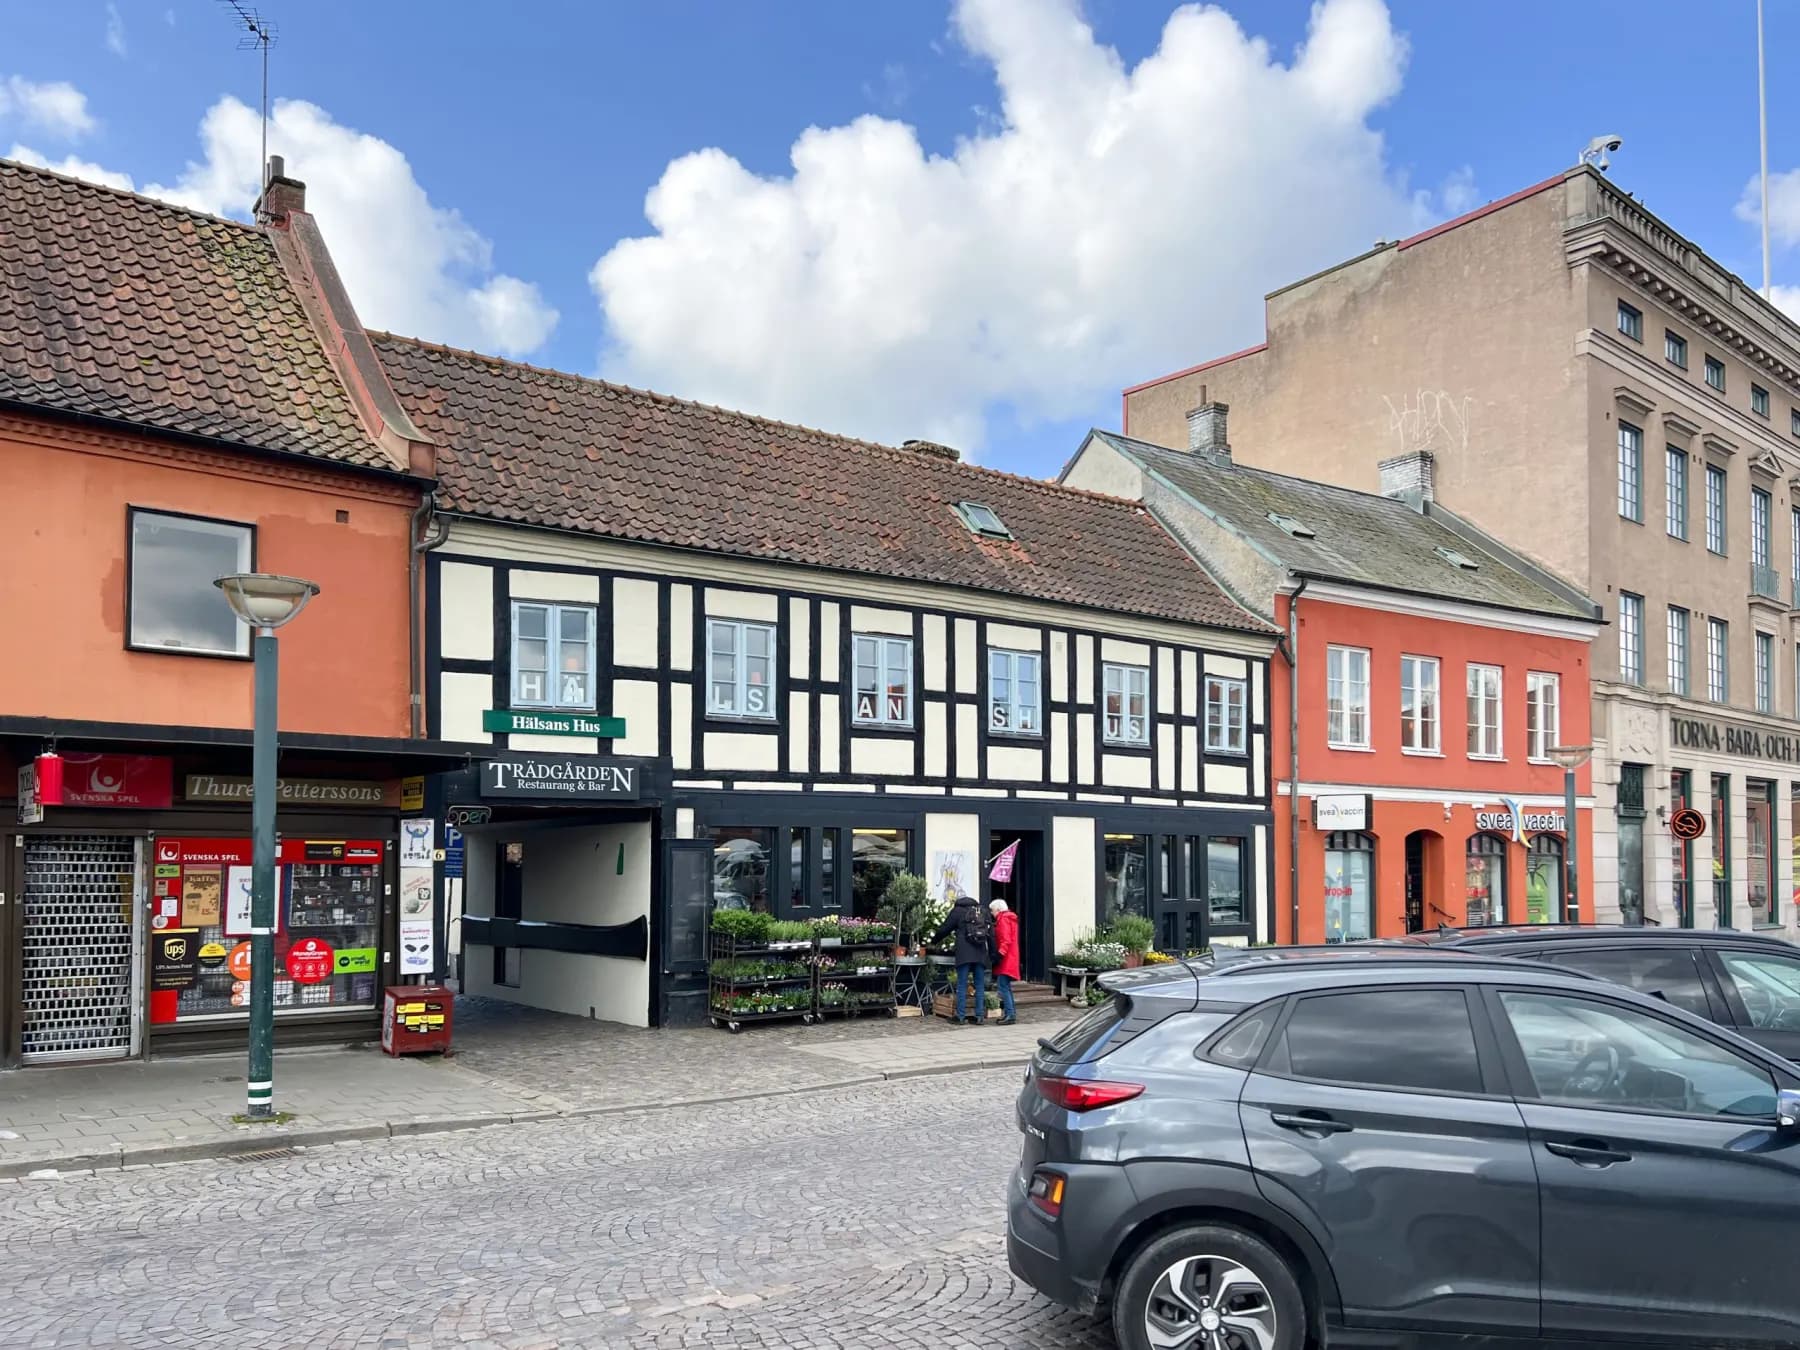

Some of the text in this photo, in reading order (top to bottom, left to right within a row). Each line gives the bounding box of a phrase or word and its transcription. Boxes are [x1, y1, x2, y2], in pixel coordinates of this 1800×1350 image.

[512, 716, 600, 733] Hälsans Hus
[1671, 717, 1720, 751] TORNA
[1726, 727, 1761, 757] BARA
[1766, 735, 1791, 761] OCH
[489, 760, 634, 792] TRÄDGÅRDEN
[192, 776, 254, 797] Thure
[517, 779, 605, 793] Restaurang & Bar
[70, 794, 140, 803] SVENSKA SPEL
[448, 811, 488, 827] open
[1478, 811, 1566, 831] svea vaccin
[449, 829, 462, 847] P
[435, 851, 442, 860] 6
[166, 945, 184, 957] ups
